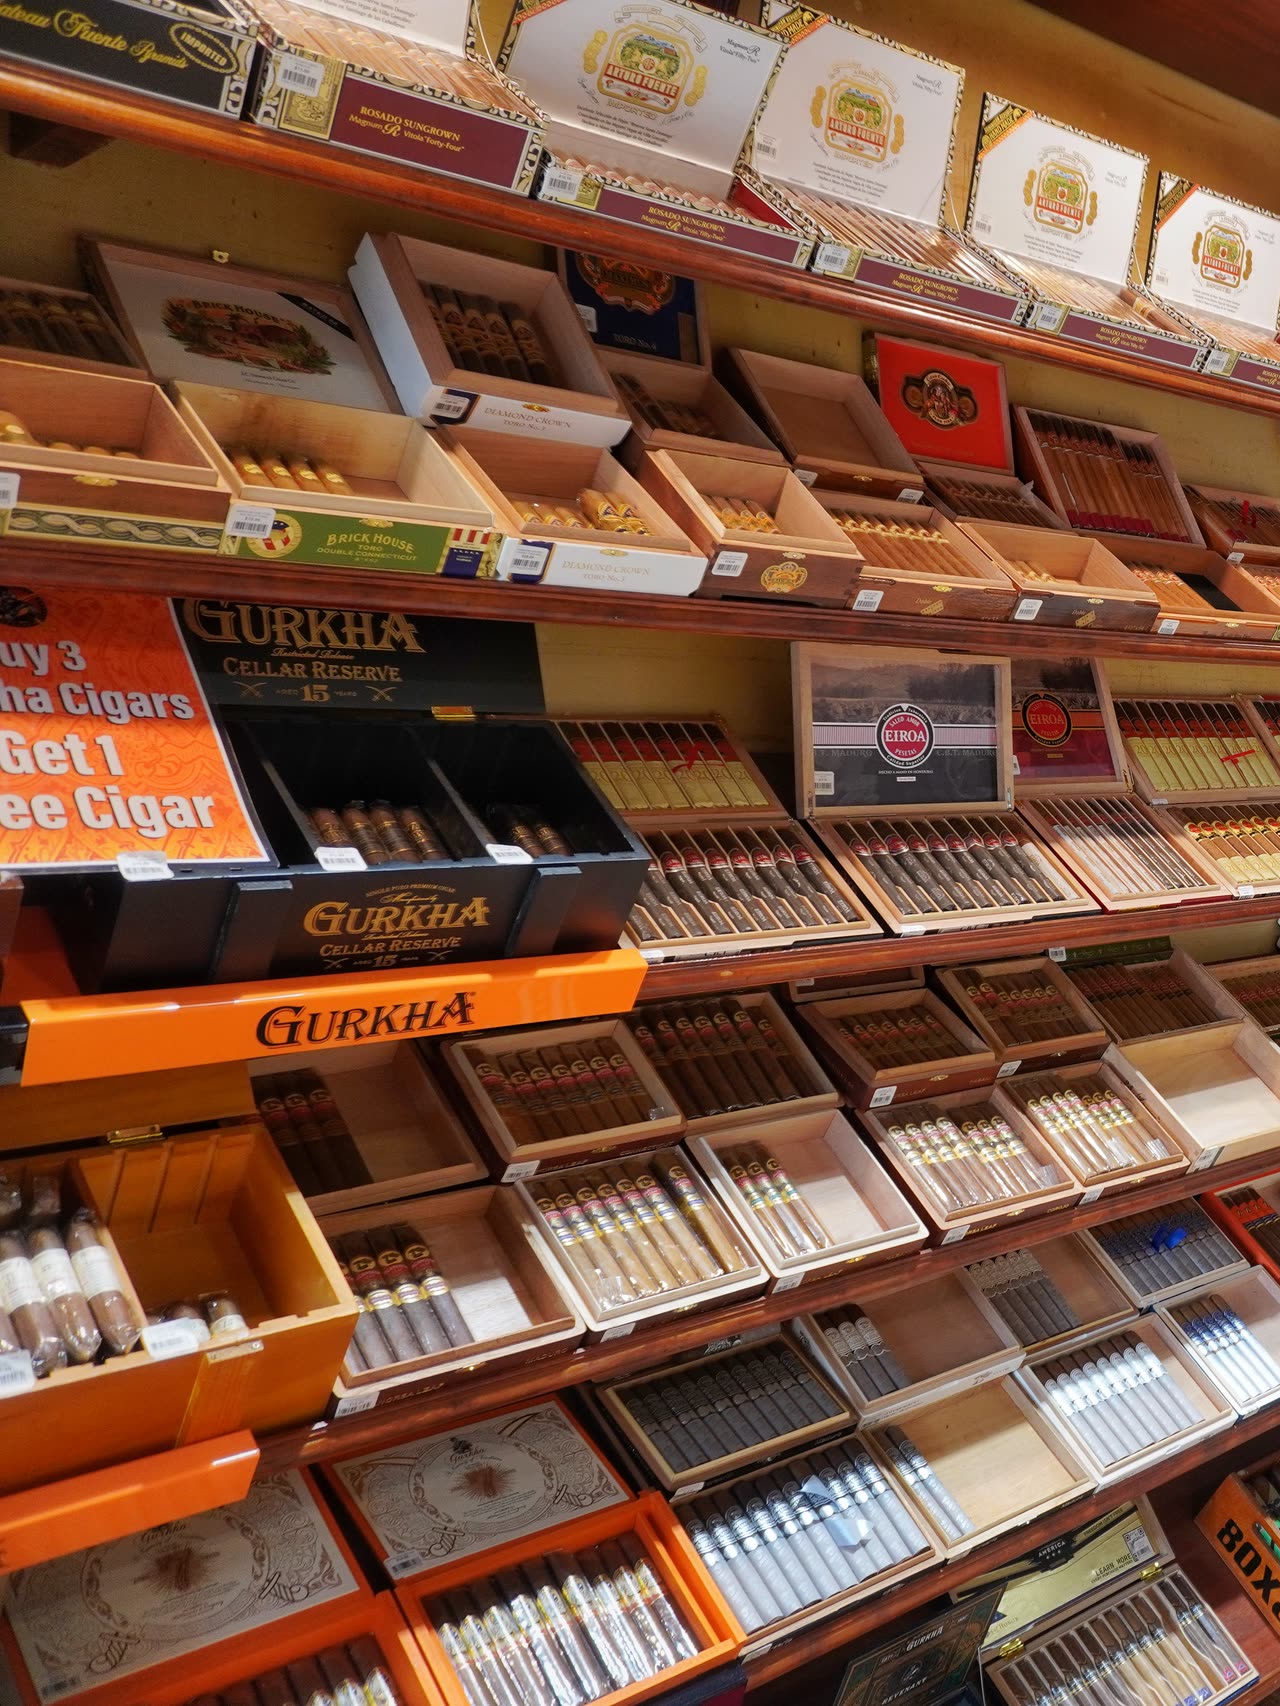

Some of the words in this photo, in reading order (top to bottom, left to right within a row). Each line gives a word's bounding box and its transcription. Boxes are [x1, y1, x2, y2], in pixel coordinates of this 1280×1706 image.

[53, 10, 128, 51] Fuente
[180, 31, 227, 67] IMPORTED
[727, 38, 749, 51] Magnum
[607, 63, 643, 85] ARTURO
[642, 75, 680, 99] FUENTE
[605, 98, 658, 121] IMPORTED
[349, 114, 384, 131] Magnum
[404, 130, 425, 142] Vitola
[360, 106, 403, 125] ROSADO
[403, 119, 461, 142] SUNGROWN
[829, 117, 858, 133] ARTURO
[856, 125, 886, 147] FUENTE
[648, 206, 682, 222] ROSADO
[680, 214, 726, 234] SUNGROWN
[1038, 197, 1061, 212] ARTURO
[1059, 202, 1083, 221] FUENTE
[640, 214, 668, 228] Magnum
[1203, 255, 1223, 270] ARTURO
[1221, 260, 1240, 275] FUENTE
[899, 273, 925, 285] ROSADO
[923, 279, 960, 295] SUNGROWN
[484, 407, 535, 423] DIAMOND
[533, 413, 574, 430] CROWN
[503, 419, 526, 429] TORO
[317, 546, 353, 557] DOUBLE
[352, 549, 417, 561] CONNECTICUT
[327, 533, 371, 546] BRICK
[373, 533, 415, 554] HOUSE
[358, 543, 383, 552] TORO
[562, 560, 613, 572] DIAMOND
[613, 565, 652, 577] CROWN
[183, 598, 428, 653] GURKHA
[57, 639, 88, 672] 3
[223, 657, 307, 678] CELLAR
[311, 660, 404, 682] RESERVE
[58, 681, 195, 726] Cigars
[301, 685, 331, 703] 15
[889, 715, 905, 729] SALUD
[905, 716, 921, 728] AMOR
[1029, 713, 1065, 725] EIROA
[885, 729, 927, 743] EIROA
[0, 729, 96, 777] Get
[96, 733, 125, 777] 1
[894, 747, 918, 758] PESETAS
[73, 786, 215, 839] Cigar
[303, 896, 492, 937] GURKHA
[319, 940, 388, 957] CELLAR
[389, 936, 463, 951] RESERVE
[371, 955, 400, 968] 15
[255, 991, 476, 1050] GURKHA
[1038, 1540, 1066, 1558] AMERICA
[1095, 1561, 1116, 1577] LEARN
[1116, 1553, 1133, 1568] MORE
[906, 1626, 945, 1652] GURKHA
[881, 1677, 928, 1706] REVENANT
